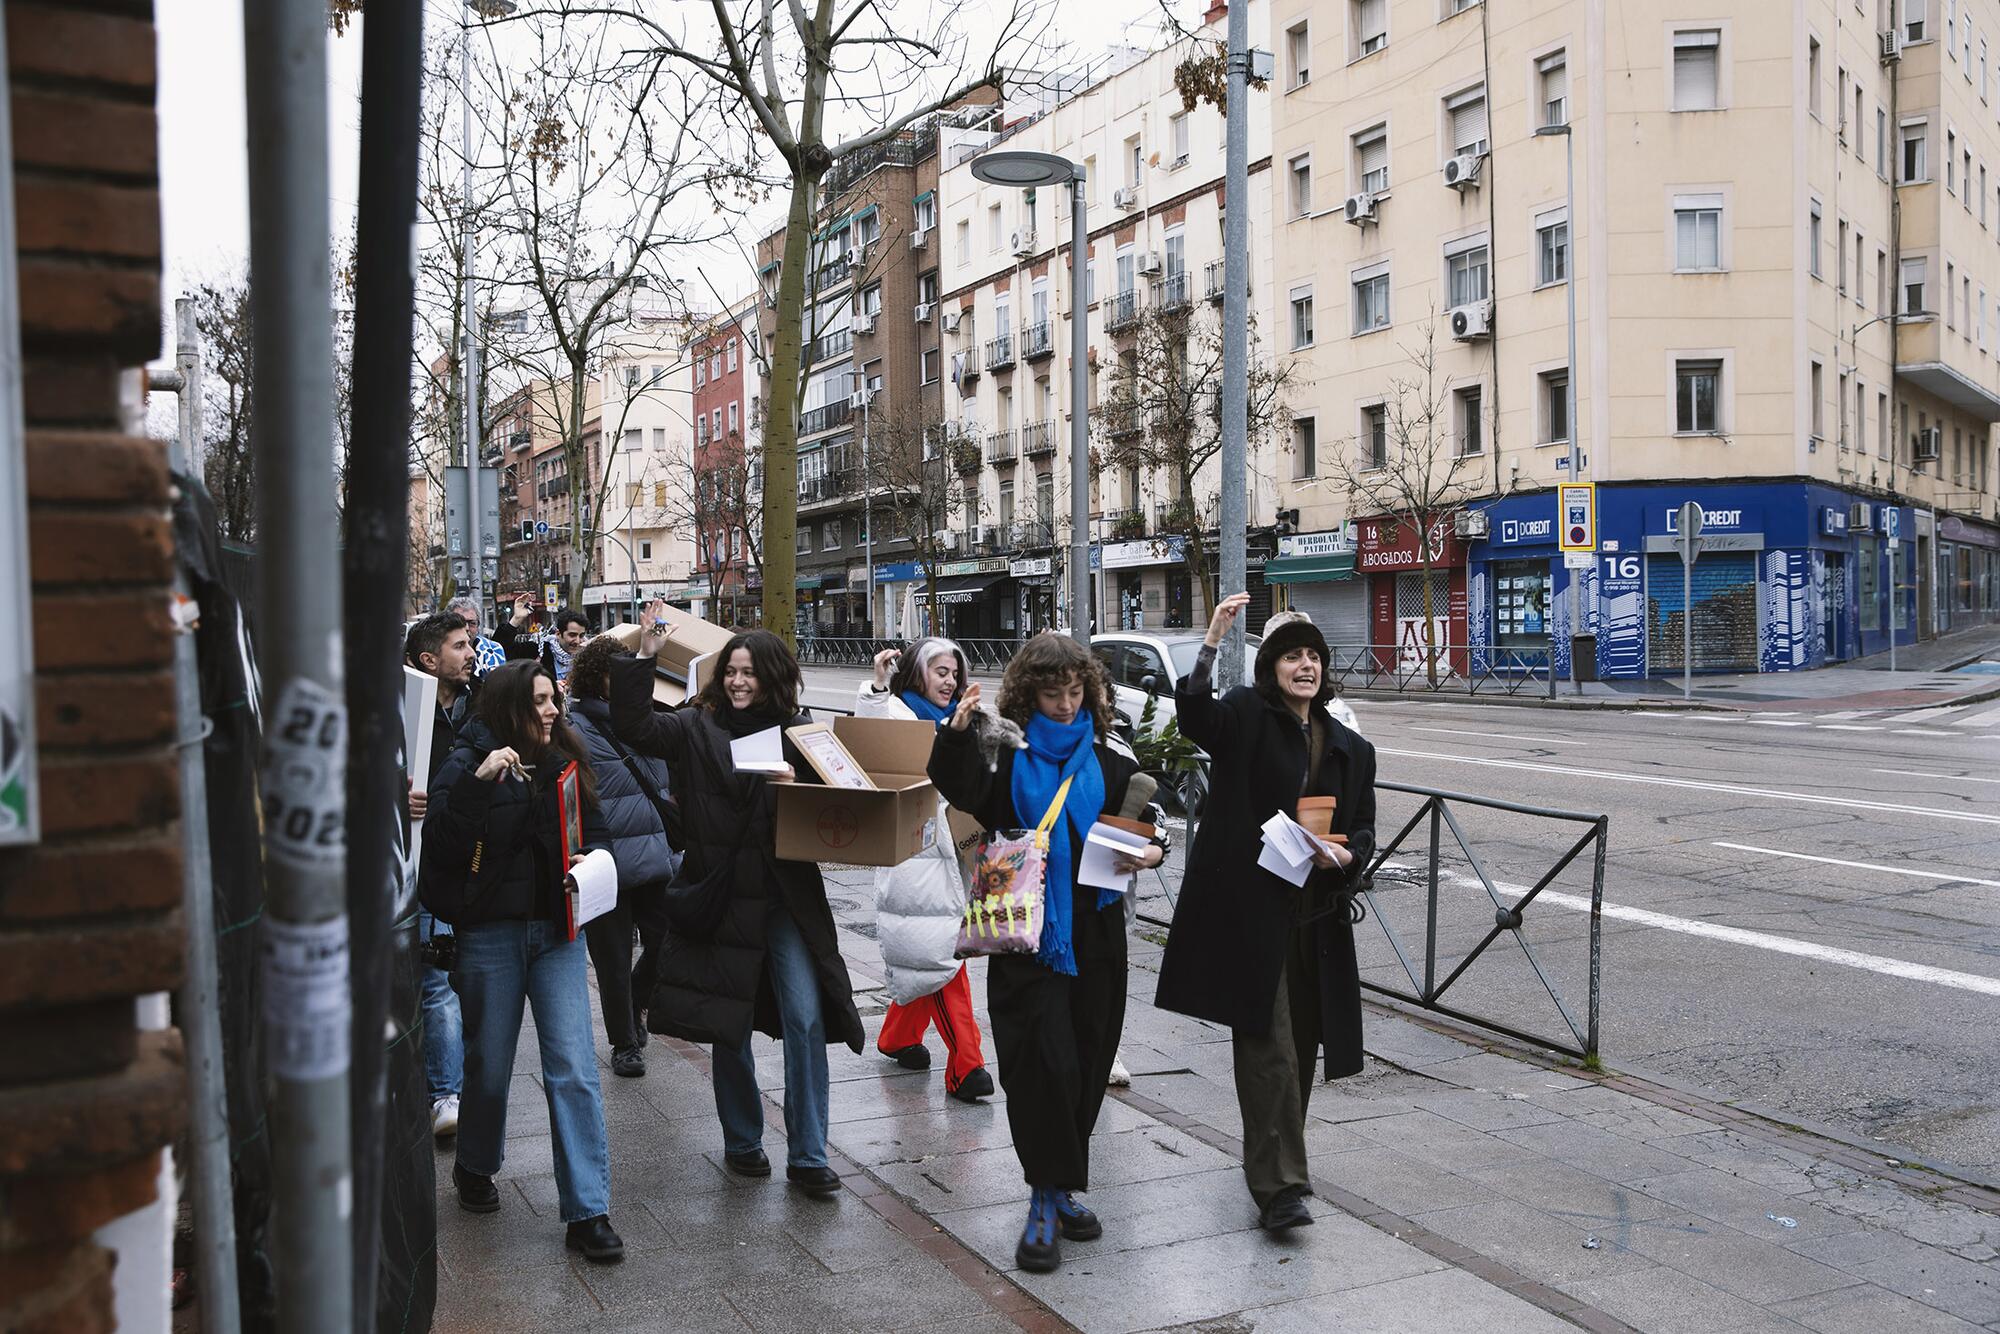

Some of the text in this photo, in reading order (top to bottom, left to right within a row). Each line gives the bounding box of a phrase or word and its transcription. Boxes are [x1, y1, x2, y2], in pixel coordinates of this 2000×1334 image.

[1702, 509, 1742, 527] CREDIT
[1366, 526, 1377, 539] 16
[1520, 520, 1551, 536] DCREDIT
[1298, 534, 1341, 546] HERBOLARI
[1304, 543, 1340, 554] PATRICIA
[1363, 550, 1412, 566] ABOGADOS
[1605, 556, 1641, 579] 16
[915, 596, 927, 606] BAR
[941, 593, 973, 604] CHIQUITOS
[471, 841, 483, 873] Nikon
